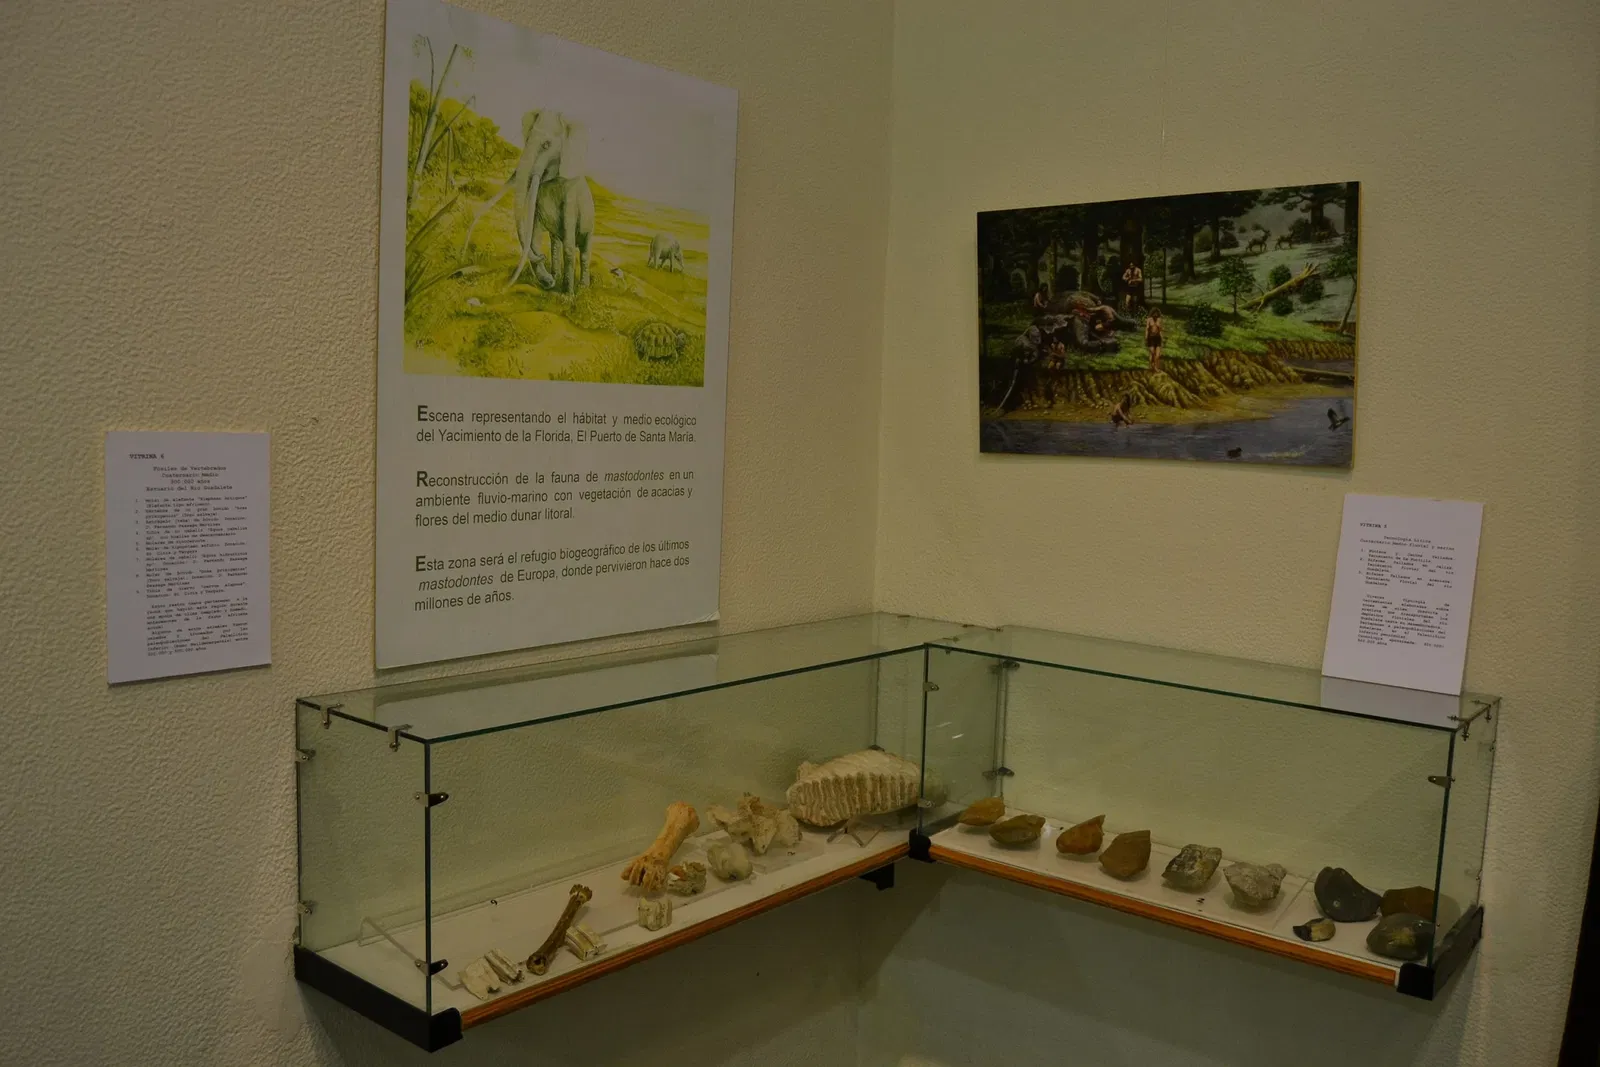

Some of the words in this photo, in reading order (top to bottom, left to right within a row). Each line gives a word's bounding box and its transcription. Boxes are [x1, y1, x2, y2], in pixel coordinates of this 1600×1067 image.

[417, 405, 464, 423] Escena
[472, 412, 551, 426] representando
[558, 412, 567, 424] el
[573, 413, 607, 425] hábitat
[612, 416, 618, 427] y
[624, 414, 652, 425] medio
[655, 414, 697, 428] ecológico
[417, 429, 435, 442] del
[438, 429, 501, 442] Yacimiento
[505, 430, 519, 442] de
[522, 430, 532, 442] la
[535, 430, 573, 444] Florida,
[577, 431, 587, 442] El
[590, 431, 622, 442] Puerto
[625, 431, 637, 442] de
[640, 431, 666, 443] Santa
[417, 470, 508, 487] Reconstrucción
[516, 472, 529, 485] de
[535, 472, 545, 484] la
[551, 471, 580, 484] fauna
[586, 471, 598, 482] de
[604, 470, 664, 482] mastodontes
[669, 471, 681, 480] en
[683, 470, 694, 480] un
[416, 494, 470, 508] ambiente
[478, 491, 548, 505] fluvio-marino
[554, 491, 573, 502] con
[579, 487, 631, 503] vegetación
[637, 487, 649, 498] de
[651, 486, 685, 498] acacias
[686, 487, 692, 499] y
[416, 513, 448, 527] flores
[452, 512, 470, 525] del
[473, 511, 508, 524] medio
[511, 510, 541, 522] dunar
[544, 507, 575, 520] litoral.
[416, 555, 445, 572] Esta
[448, 558, 476, 570] zona
[480, 554, 504, 567] será
[508, 553, 518, 565] el
[521, 549, 556, 565] refugio
[560, 544, 626, 560] biogeográfico
[628, 543, 640, 554] de
[642, 542, 656, 553] los
[658, 540, 690, 552] últimos
[418, 573, 494, 592] mastodontes
[500, 570, 514, 583] de
[518, 567, 558, 582] Europa,
[561, 564, 592, 578] donde
[595, 559, 647, 576] pervivieron
[650, 557, 671, 569] hace
[674, 556, 690, 567] dos
[414, 595, 463, 612] millones
[467, 592, 481, 605] de
[485, 591, 515, 603] años.
